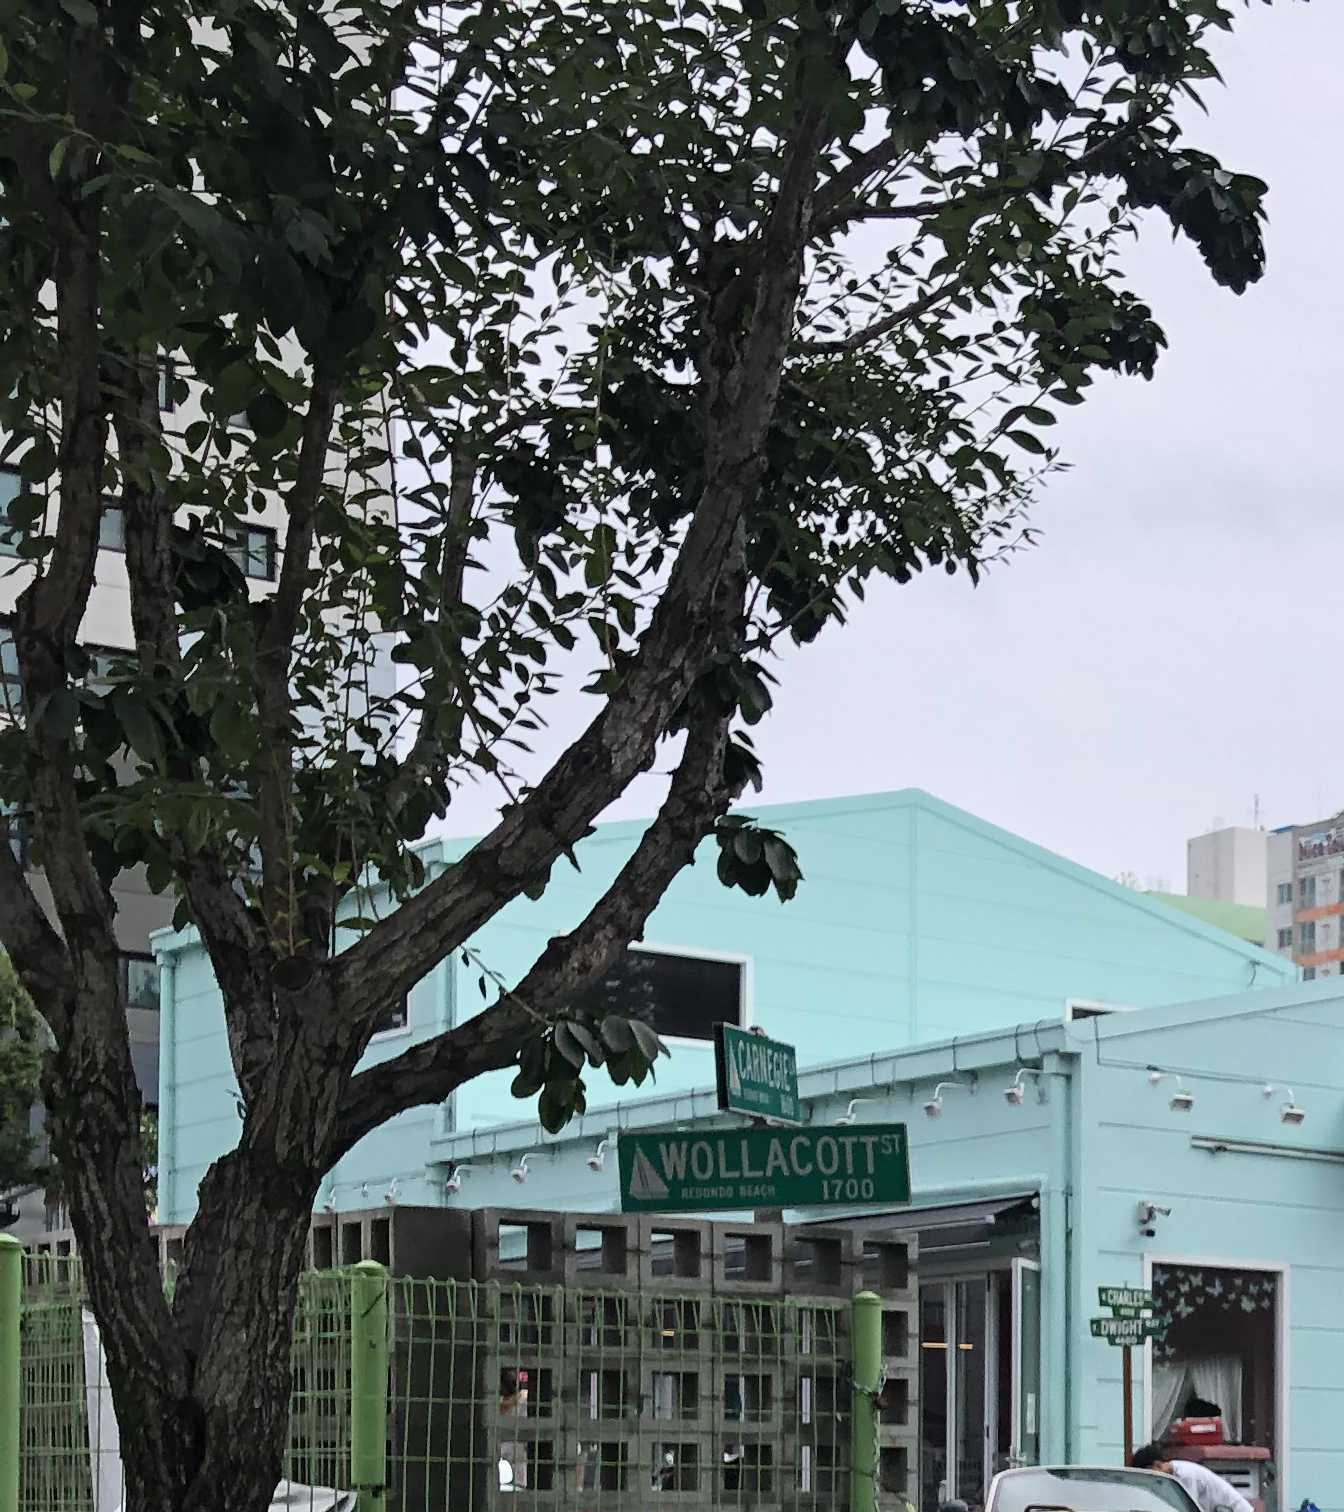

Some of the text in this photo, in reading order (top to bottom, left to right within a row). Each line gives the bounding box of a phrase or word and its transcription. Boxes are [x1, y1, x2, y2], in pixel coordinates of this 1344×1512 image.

[737, 1039, 791, 1093] CARNEGIE
[658, 1134, 900, 1181] WOLLACOTT ST
[681, 1179, 875, 1201] REDONDO BEACH 1700
[1101, 1319, 1143, 1336] DWIGHT
